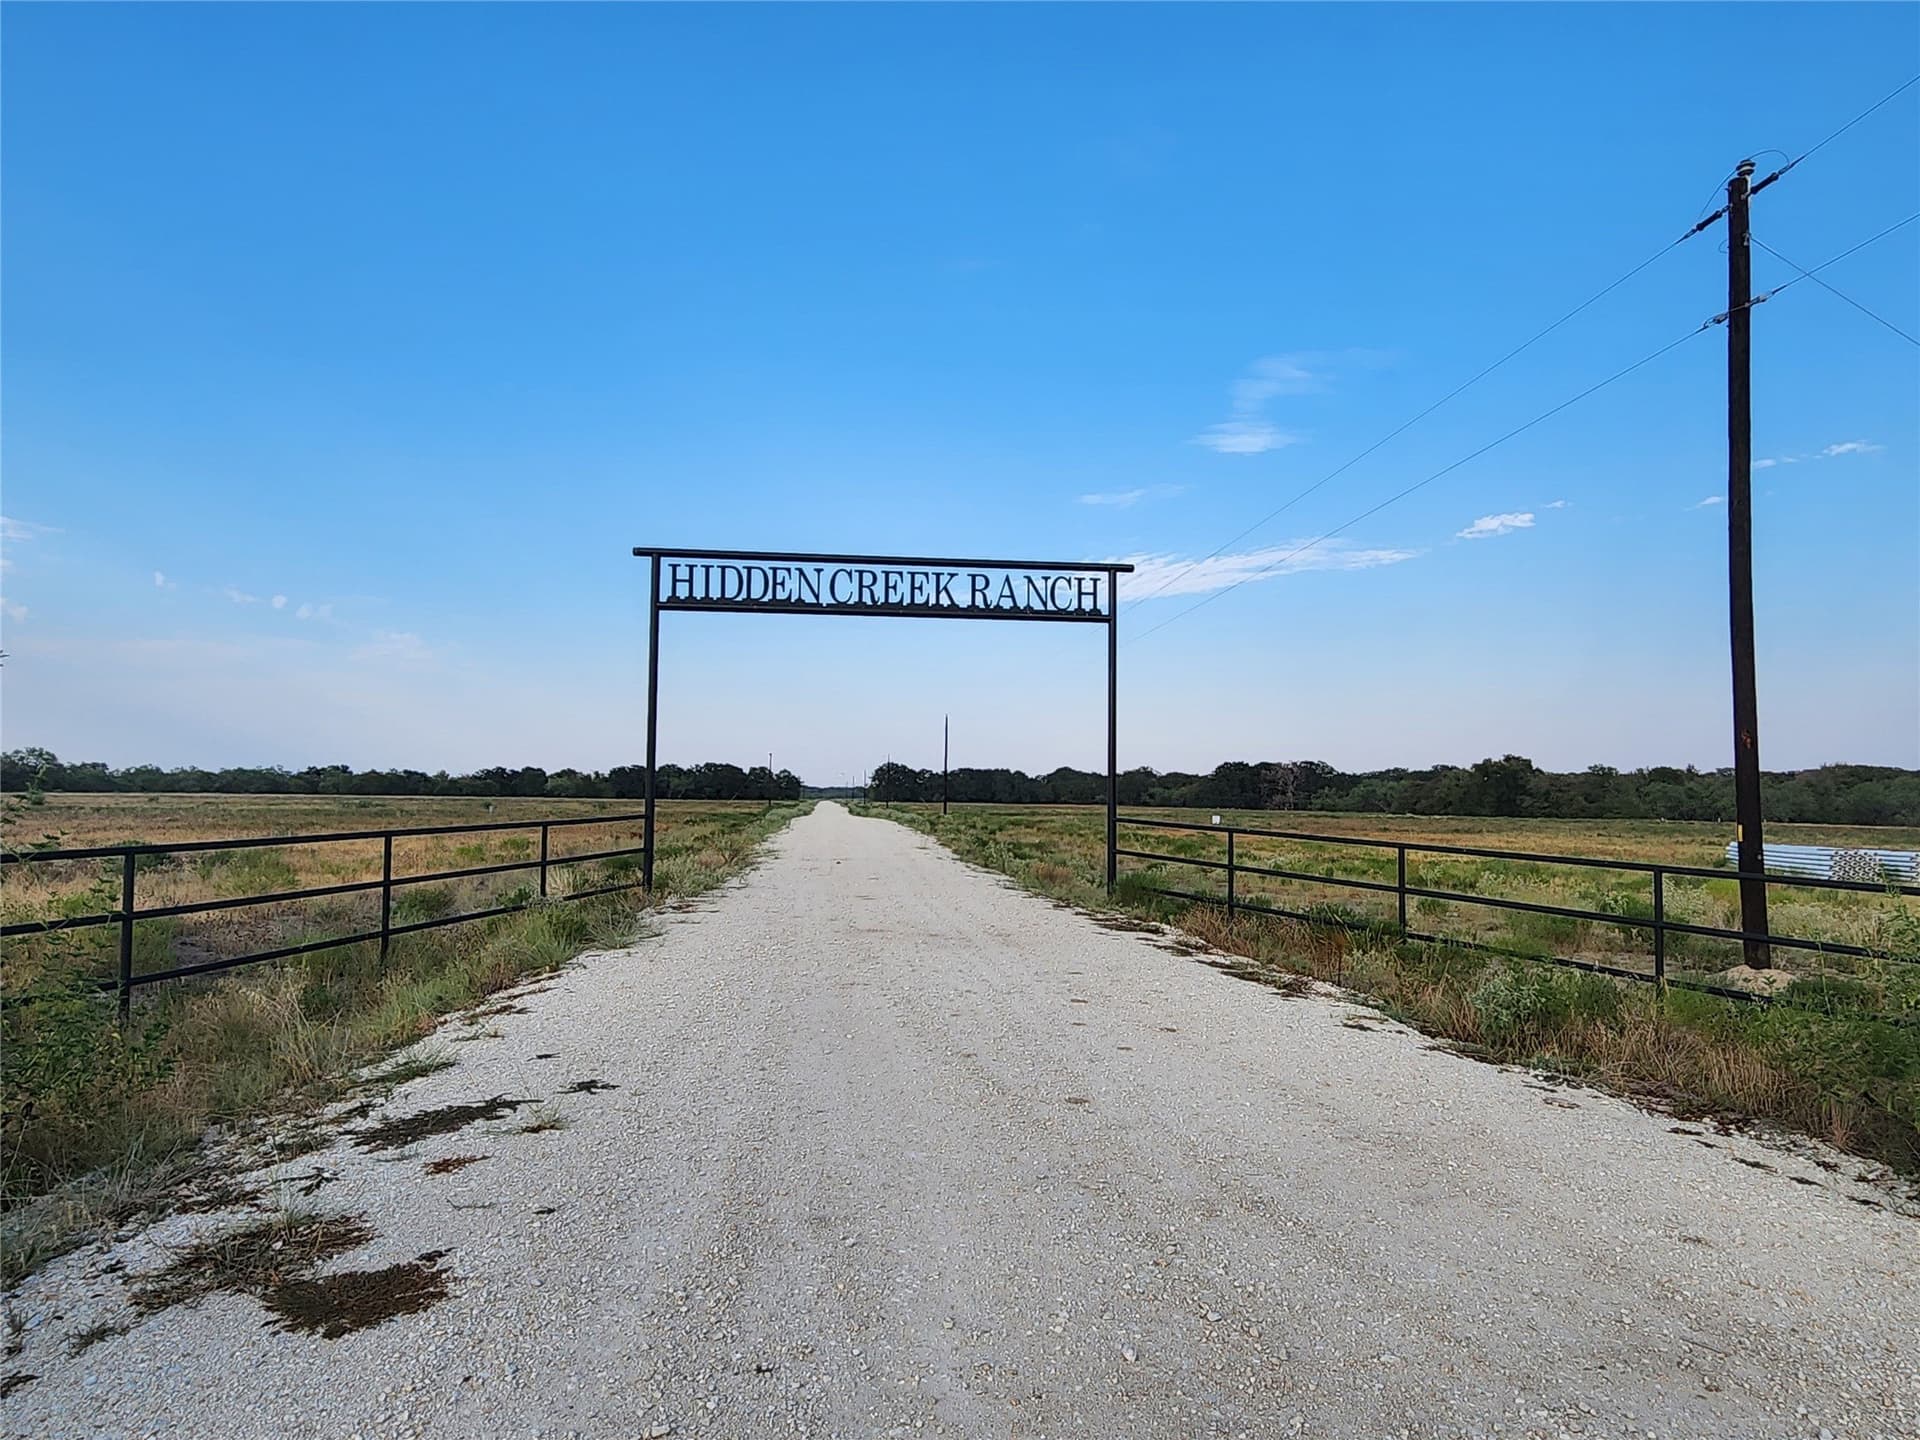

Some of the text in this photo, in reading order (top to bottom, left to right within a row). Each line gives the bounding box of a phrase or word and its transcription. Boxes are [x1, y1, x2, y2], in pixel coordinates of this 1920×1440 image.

[668, 564, 1102, 615] HIDDEN CREEK RANCH
